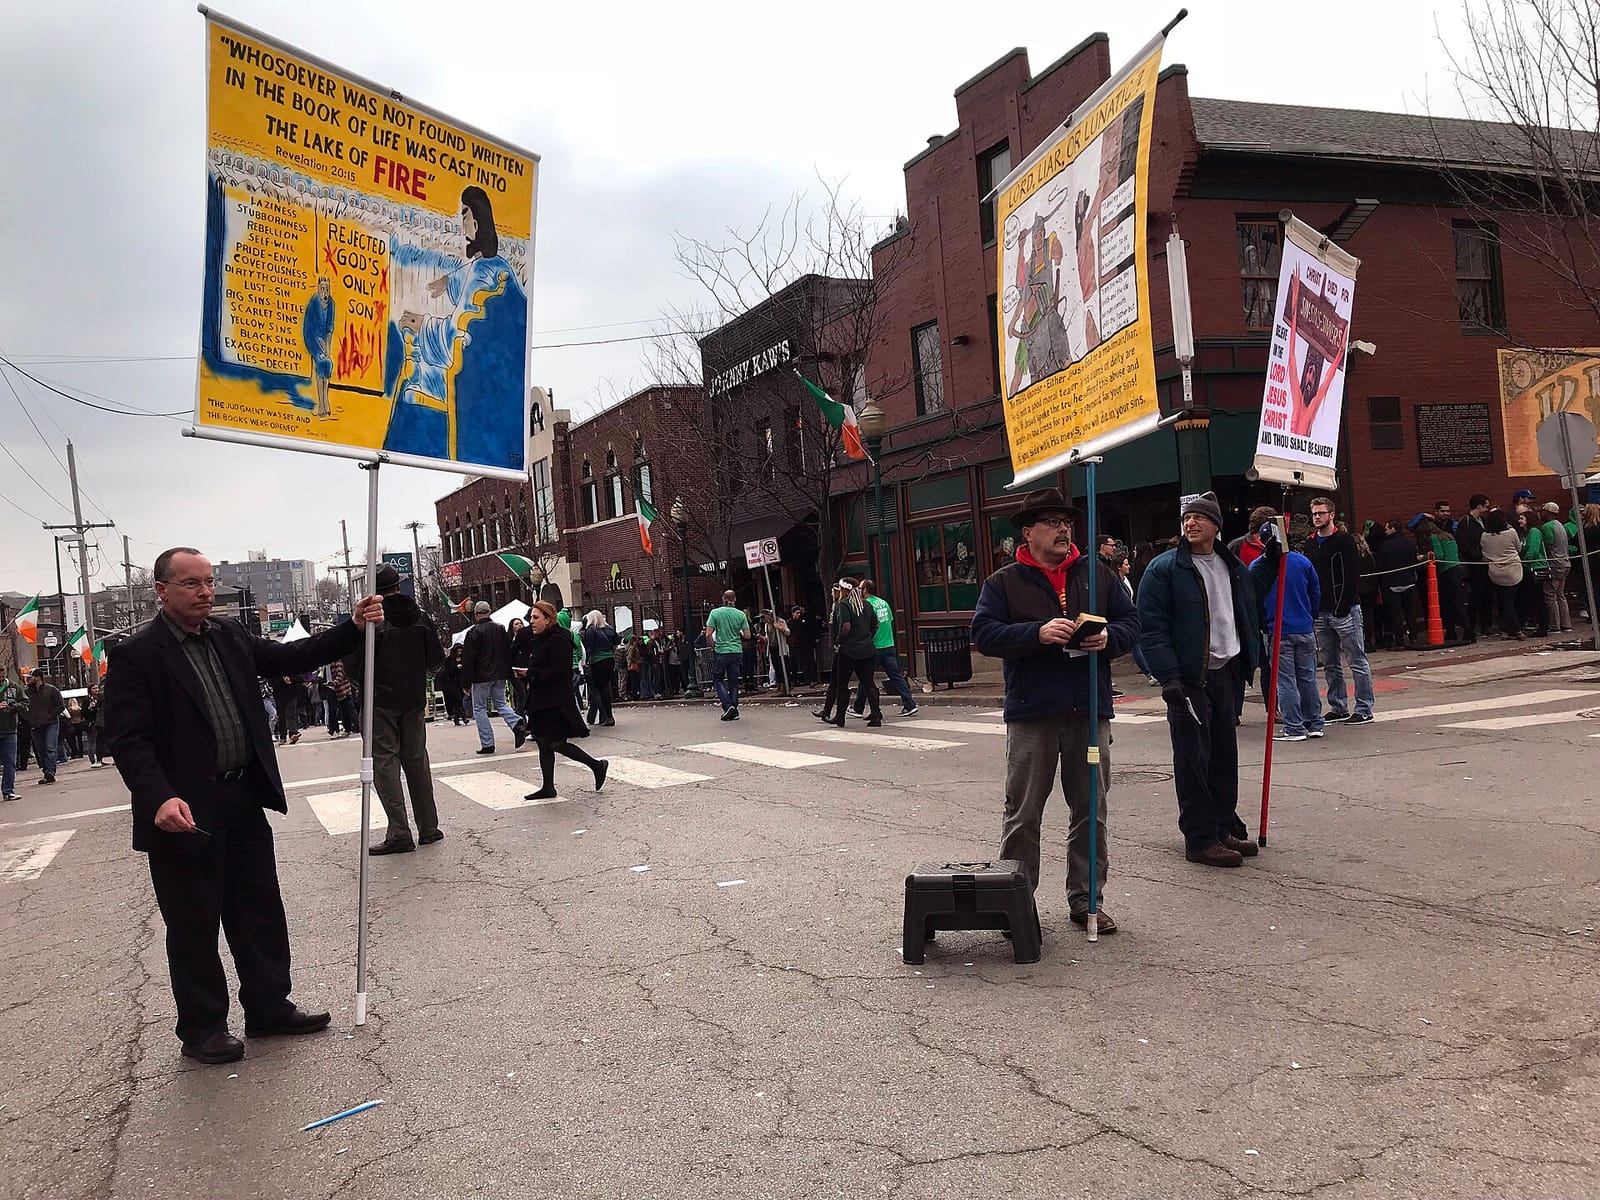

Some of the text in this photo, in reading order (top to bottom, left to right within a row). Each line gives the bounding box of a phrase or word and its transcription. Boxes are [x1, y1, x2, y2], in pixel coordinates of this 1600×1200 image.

[225, 67, 506, 192] IN THE BOOK OF LIFE WAS CAST INTO
[343, 86, 377, 116] WAS
[383, 106, 415, 130] NOT
[419, 116, 466, 152] FOUND
[472, 142, 524, 176] WRITTEN
[266, 114, 296, 144] THE
[304, 128, 344, 160] LAKE
[349, 146, 368, 168] OF
[1066, 130, 1081, 158] OR
[276, 146, 356, 182] Revelation 20:15
[237, 204, 308, 232] STUBBORNNESS
[251, 196, 296, 218] LAZINESS
[248, 220, 298, 240] REBELLION
[328, 223, 386, 255] REJECTED
[248, 233, 294, 252] SELF-WILL
[236, 242, 265, 258] PRIDE
[274, 250, 298, 266] ENVY
[337, 248, 379, 276] GOD'S
[225, 264, 254, 278] DIRTY
[256, 271, 306, 290] THOUGHTS
[234, 254, 307, 279] COVETOUSNESS
[244, 280, 265, 293] LUST
[275, 287, 290, 297] SIN
[343, 275, 376, 297] ONLY
[226, 289, 243, 301] BIG
[248, 294, 270, 306] SINS
[277, 300, 304, 313] LITTLE
[349, 299, 373, 320] SON
[231, 302, 297, 324] SCARLET SINS
[231, 314, 292, 334] YELLOW SINS
[225, 337, 302, 360] EXAGGERATION
[240, 329, 296, 346] BLACK SINS
[237, 353, 257, 364] LIES
[266, 359, 298, 371] DECEIT
[1127, 358, 1139, 373] and
[1270, 362, 1285, 384] LORD
[709, 360, 749, 398] JOHNNY
[1047, 376, 1066, 388] Either
[1266, 386, 1287, 408] JESUS
[207, 411, 220, 419] THE
[222, 414, 248, 424] BOOKS
[250, 418, 268, 427] WERE
[226, 403, 264, 415] JUDGMENT
[266, 409, 282, 418] WAS
[296, 416, 310, 424] AND
[1264, 408, 1288, 431] CHRIST
[1261, 430, 1272, 445] AND
[1273, 433, 1289, 449] THOU
[1290, 437, 1307, 452] SHALT
[390, 557, 408, 567] AC
